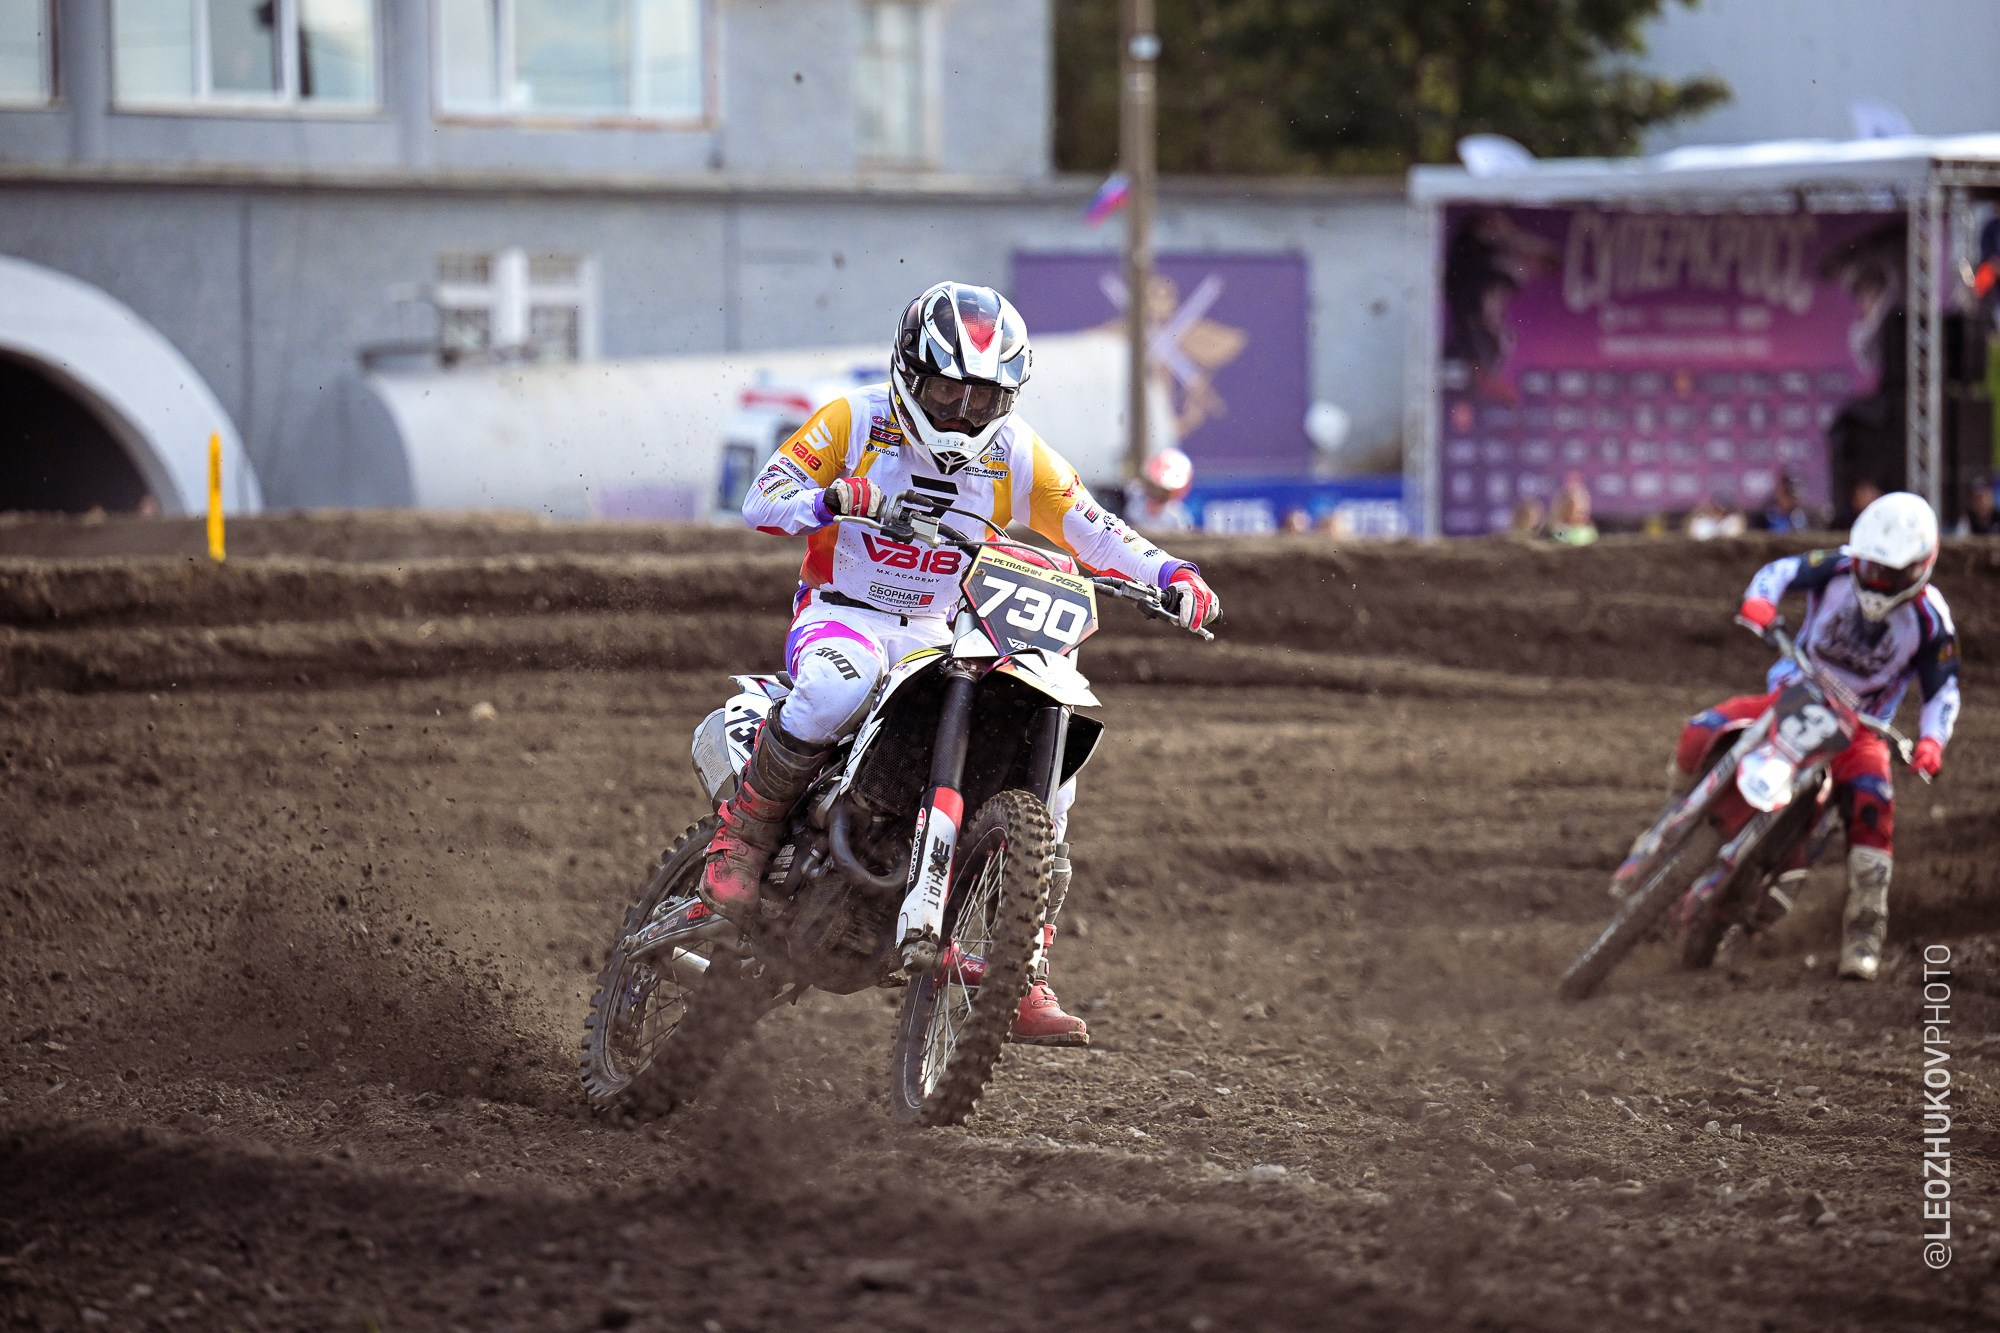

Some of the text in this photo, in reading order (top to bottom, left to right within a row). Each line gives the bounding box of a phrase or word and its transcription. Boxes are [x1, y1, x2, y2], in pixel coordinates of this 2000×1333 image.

[792, 441, 822, 471] VB18
[874, 447, 899, 458] LADOGA
[962, 466, 1009, 477] AUTO-MARKET
[860, 531, 962, 575] VB18
[895, 573, 940, 583] ACADEMY
[993, 557, 1042, 577] PETRASHIN
[869, 585, 920, 601] СБОРНАЯ
[976, 575, 1089, 646] 730
[1006, 637, 1042, 650] VB1
[815, 647, 861, 680] SHOT
[1780, 704, 1839, 751] 3
[927, 862, 945, 909] HOT
